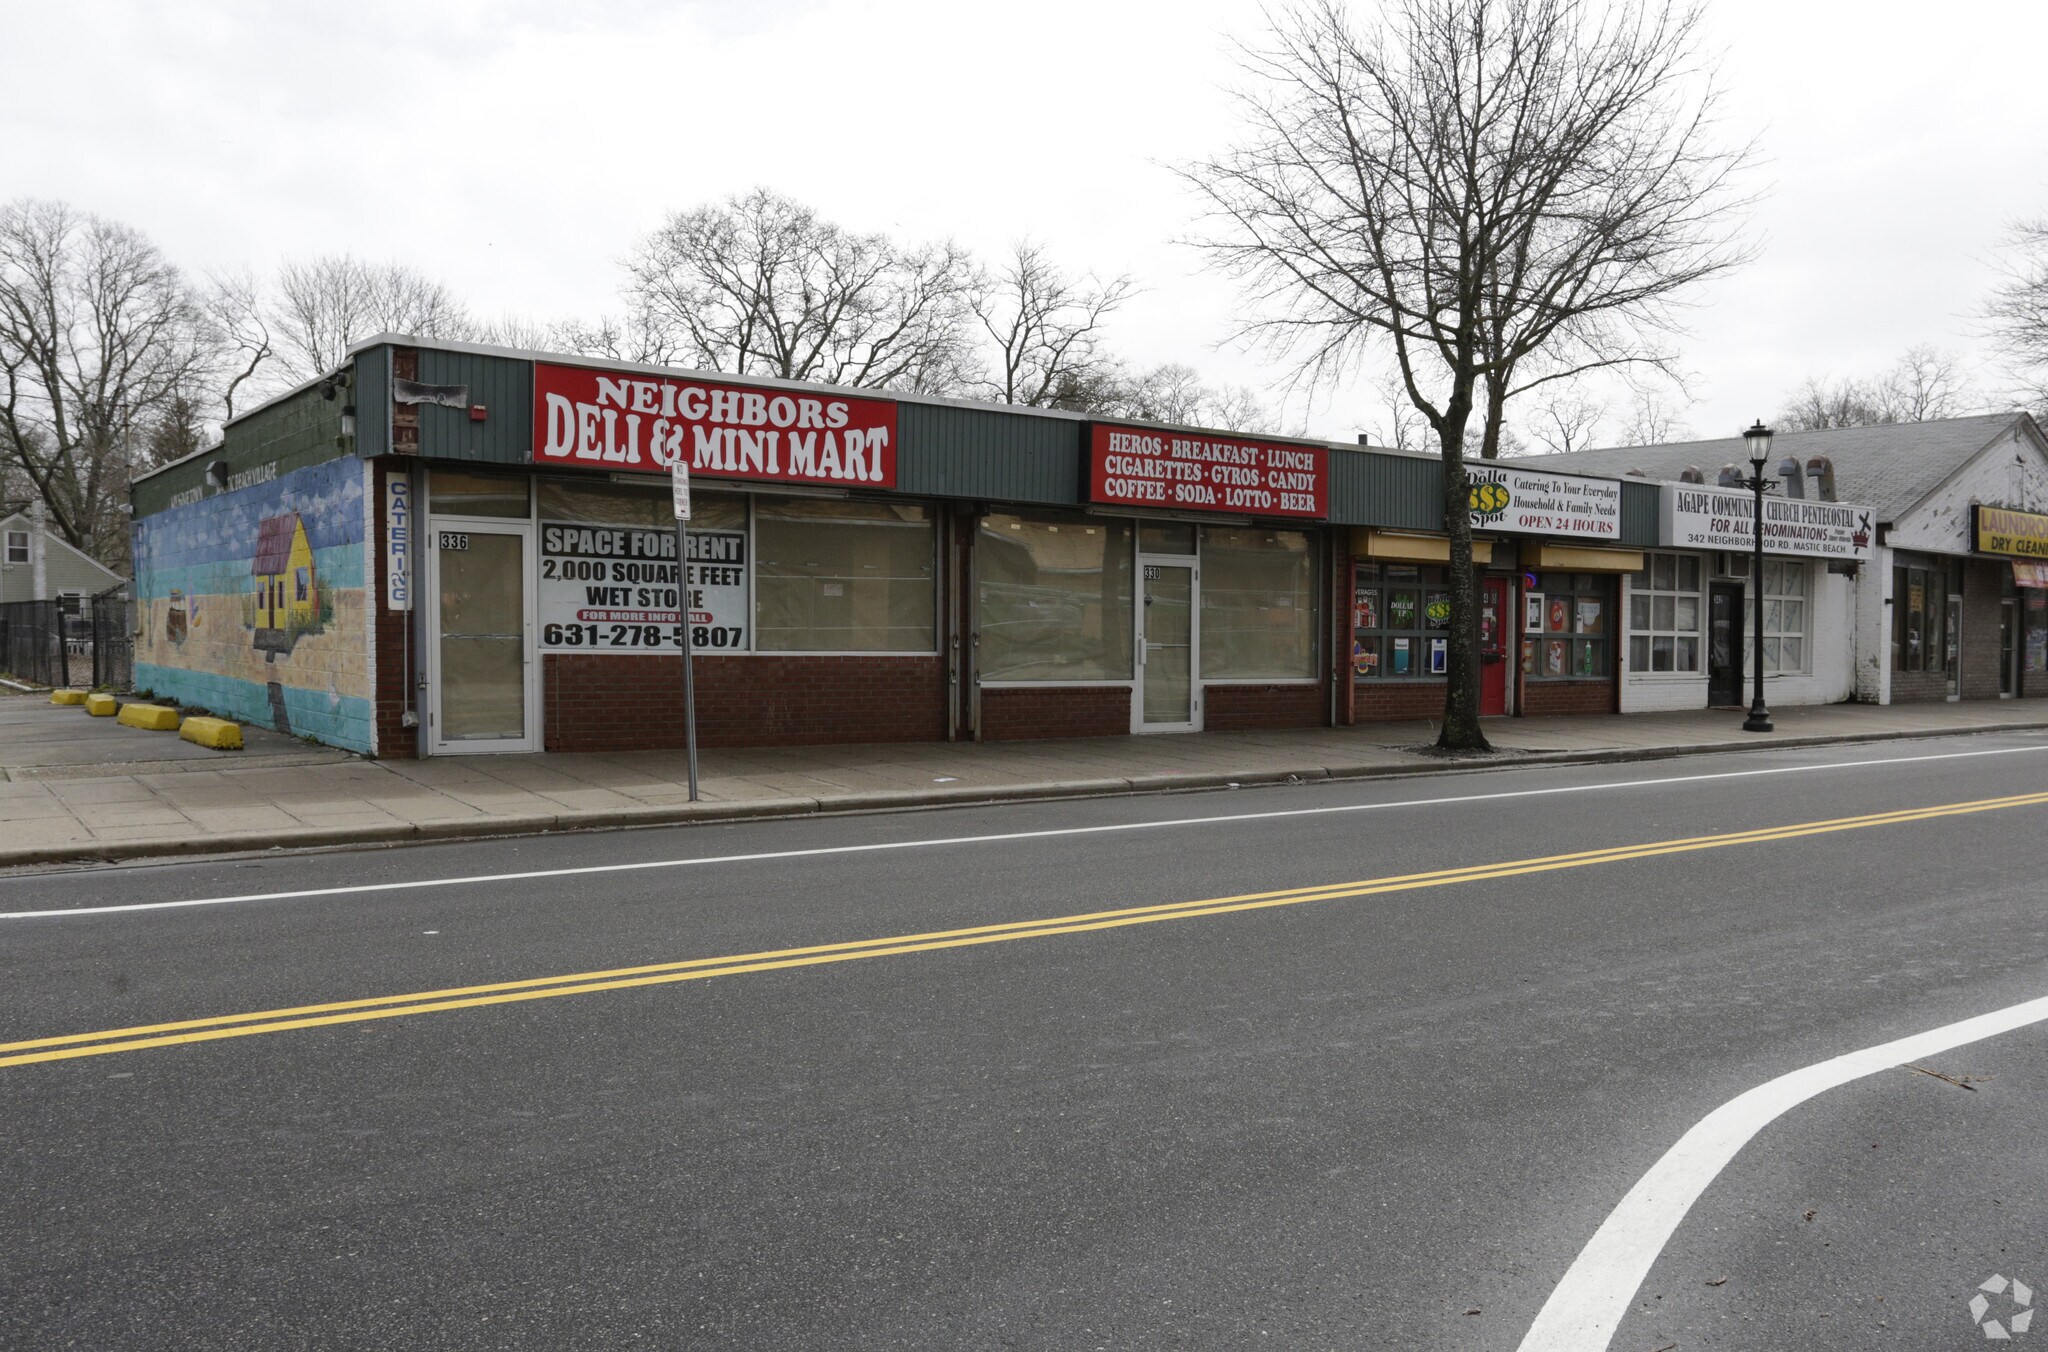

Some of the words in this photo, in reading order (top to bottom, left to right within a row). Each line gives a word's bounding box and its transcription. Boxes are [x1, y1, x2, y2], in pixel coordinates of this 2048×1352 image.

[595, 376, 849, 430] NEIGHBORS
[544, 392, 642, 464] DELI
[649, 419, 684, 467] &
[692, 424, 781, 475] MINI
[787, 425, 889, 482] MART
[1109, 432, 1162, 456] HEROS
[1171, 439, 1258, 466] BREAKFAST
[1267, 449, 1314, 471] LUNCH
[1104, 455, 1202, 482] CIGARETTES
[1211, 465, 1259, 487] GYROS
[1268, 470, 1316, 491] CANDY
[1104, 477, 1166, 501] COFFEE
[1175, 483, 1216, 505] SODA
[1225, 487, 1272, 508] LOTTO
[1280, 492, 1316, 512] BEER
[1514, 477, 1550, 495] Catering
[1552, 480, 1562, 493] To
[1564, 482, 1581, 495] Your
[1583, 484, 1618, 502] Everyday
[1513, 495, 1556, 511] Household
[1557, 500, 1564, 512] &
[1566, 500, 1593, 517] Family
[1594, 503, 1616, 516] Needs
[1677, 491, 1710, 514] AGAPE
[1712, 495, 1764, 519] COMMUNI
[1766, 501, 1800, 523] CHURCH
[1802, 504, 1855, 528] PENTECOSTAL
[1470, 510, 1505, 528] Spot
[1518, 514, 1553, 528] OPEN
[1555, 518, 1570, 530] 24
[1573, 519, 1614, 534] HOURS
[1710, 518, 1731, 533] FOR
[1733, 520, 1749, 535] ALL
[1752, 522, 1828, 541] ENOMINATIONS
[1981, 509, 2048, 540] LAUNDRO
[390, 482, 407, 601] CATERING
[442, 534, 468, 549] 336
[546, 527, 625, 556] SPACE
[631, 532, 676, 558] FOR
[685, 534, 741, 561] RENT
[1687, 533, 1705, 543] 342
[1707, 535, 1775, 548] NEIGHBORHOD
[1777, 540, 1792, 550] RD.
[1793, 542, 1821, 552] MASTIC
[1822, 544, 1846, 554] BEACH
[1991, 536, 2012, 551] DRY
[542, 559, 606, 582] 2,000
[612, 562, 695, 585] SQUARE
[699, 566, 743, 586] FEET
[1145, 568, 1160, 579] 330
[586, 586, 632, 607] WET
[1390, 601, 1414, 610] DOLLAR
[582, 611, 607, 621] FOR
[609, 612, 646, 622] MORE
[648, 612, 676, 622] INFO
[678, 613, 707, 623] ALL
[544, 623, 743, 648] 631-278-5807
